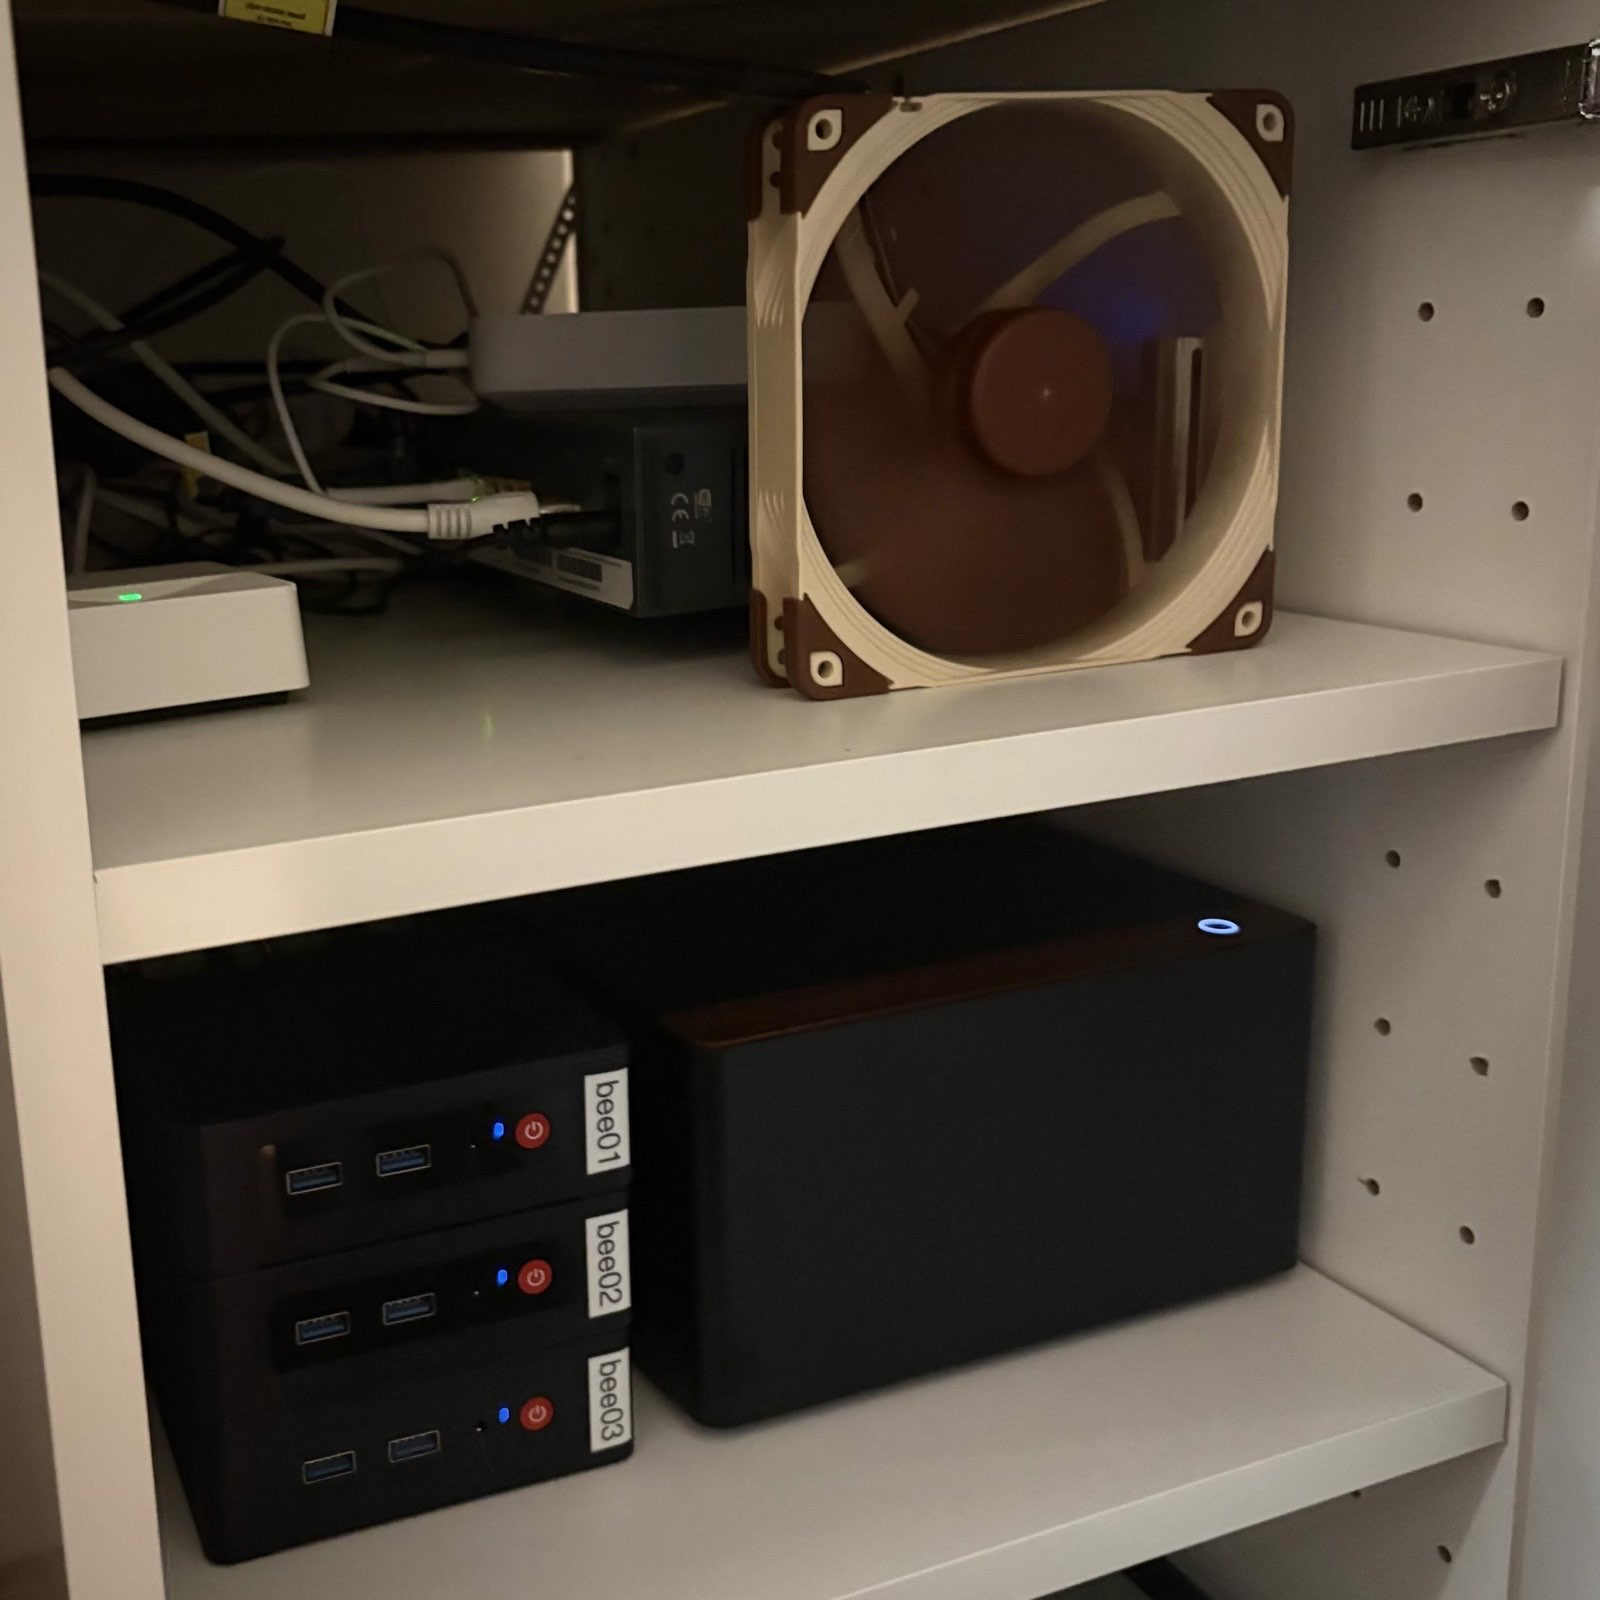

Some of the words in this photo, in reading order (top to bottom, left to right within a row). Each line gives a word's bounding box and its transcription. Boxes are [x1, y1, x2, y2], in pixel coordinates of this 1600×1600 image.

[596, 1080, 621, 1164] bee01
[597, 1220, 623, 1307] bee02
[599, 1358, 625, 1442] bee03
